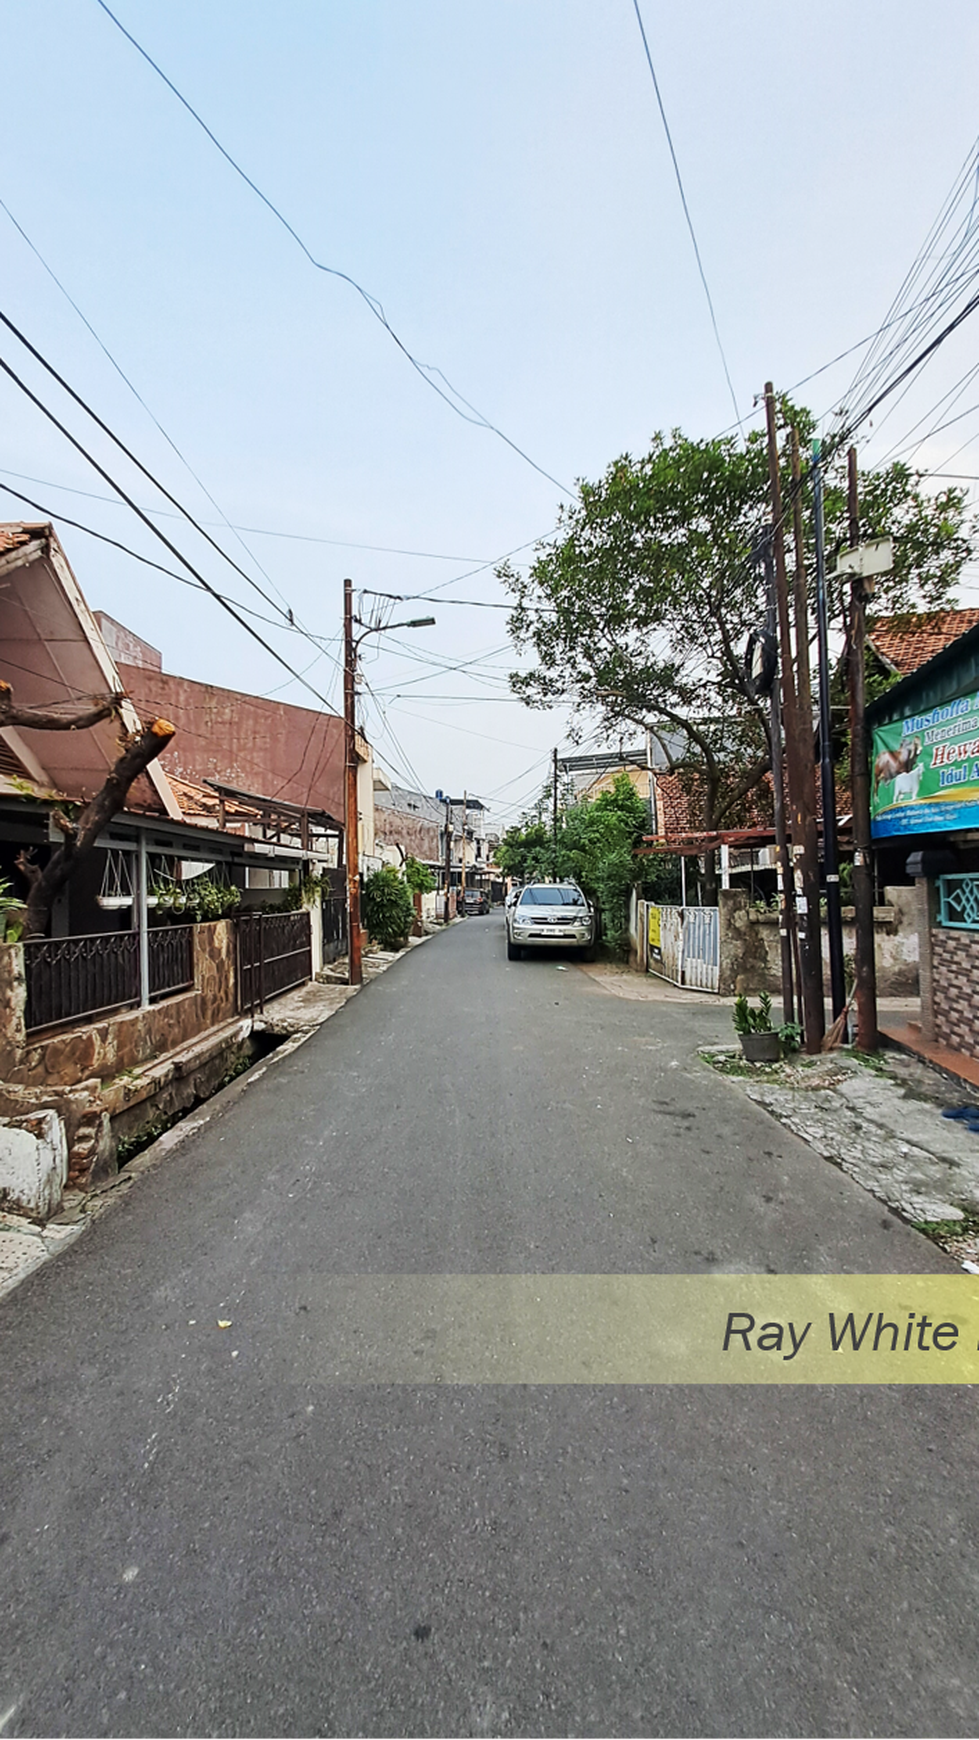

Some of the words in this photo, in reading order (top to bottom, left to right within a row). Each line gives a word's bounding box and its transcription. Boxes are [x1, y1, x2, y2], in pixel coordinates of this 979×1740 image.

[902, 698, 970, 735] Musholla
[925, 718, 978, 744] Menerima
[940, 764, 967, 786] Idul
